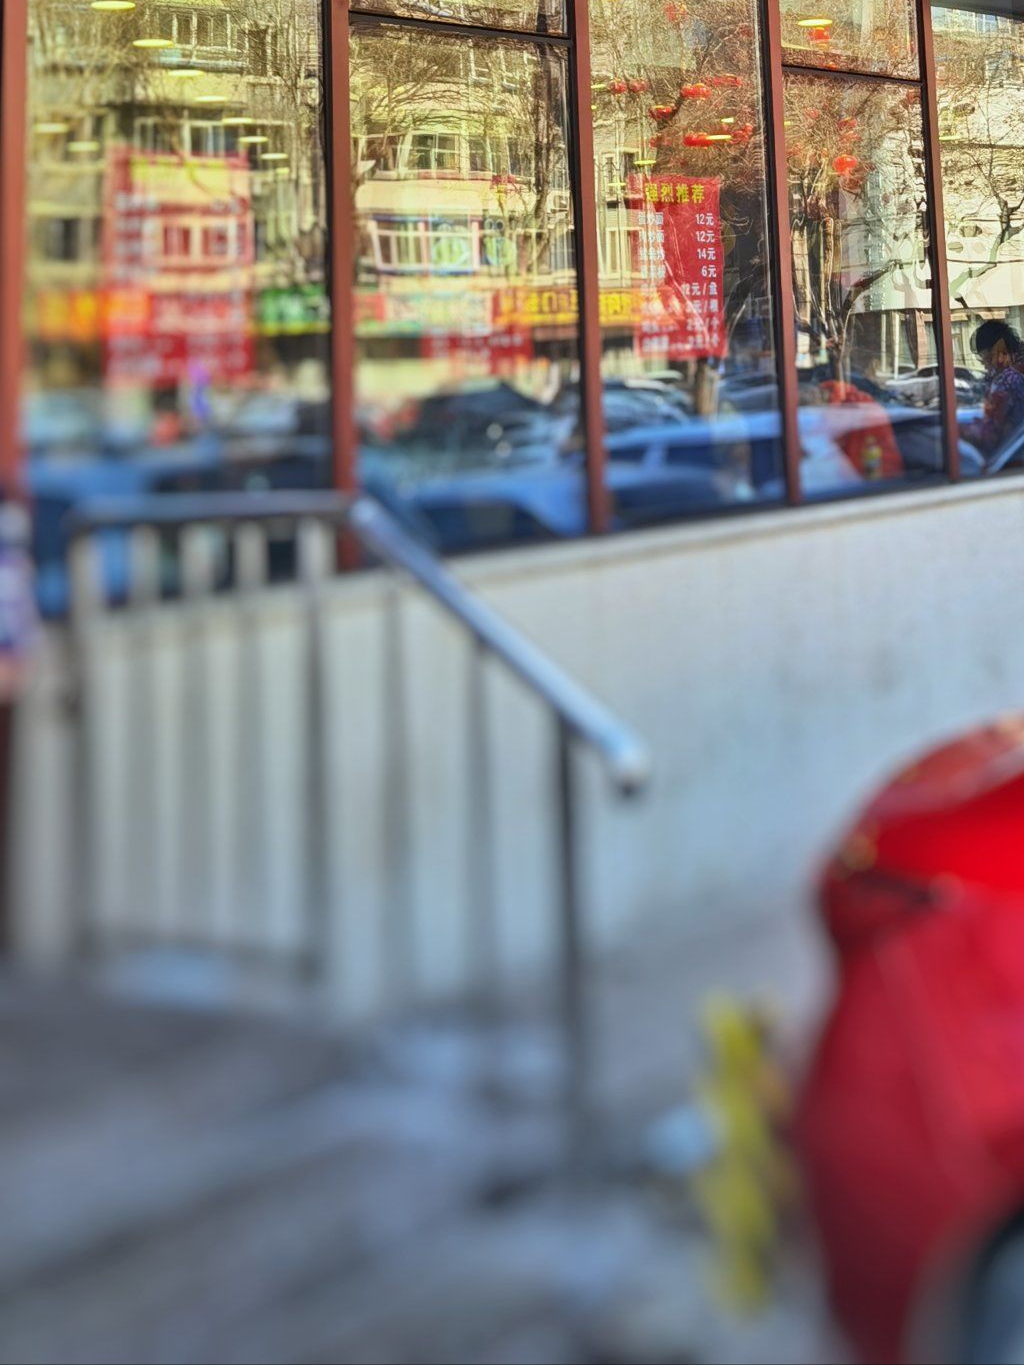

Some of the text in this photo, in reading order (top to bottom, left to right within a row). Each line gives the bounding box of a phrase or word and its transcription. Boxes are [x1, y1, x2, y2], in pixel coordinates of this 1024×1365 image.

[644, 182, 705, 204] 强烈推荐
[695, 212, 714, 226] 12元
[695, 230, 715, 244] 12元
[697, 247, 716, 261] 14元
[701, 264, 717, 278] 6元
